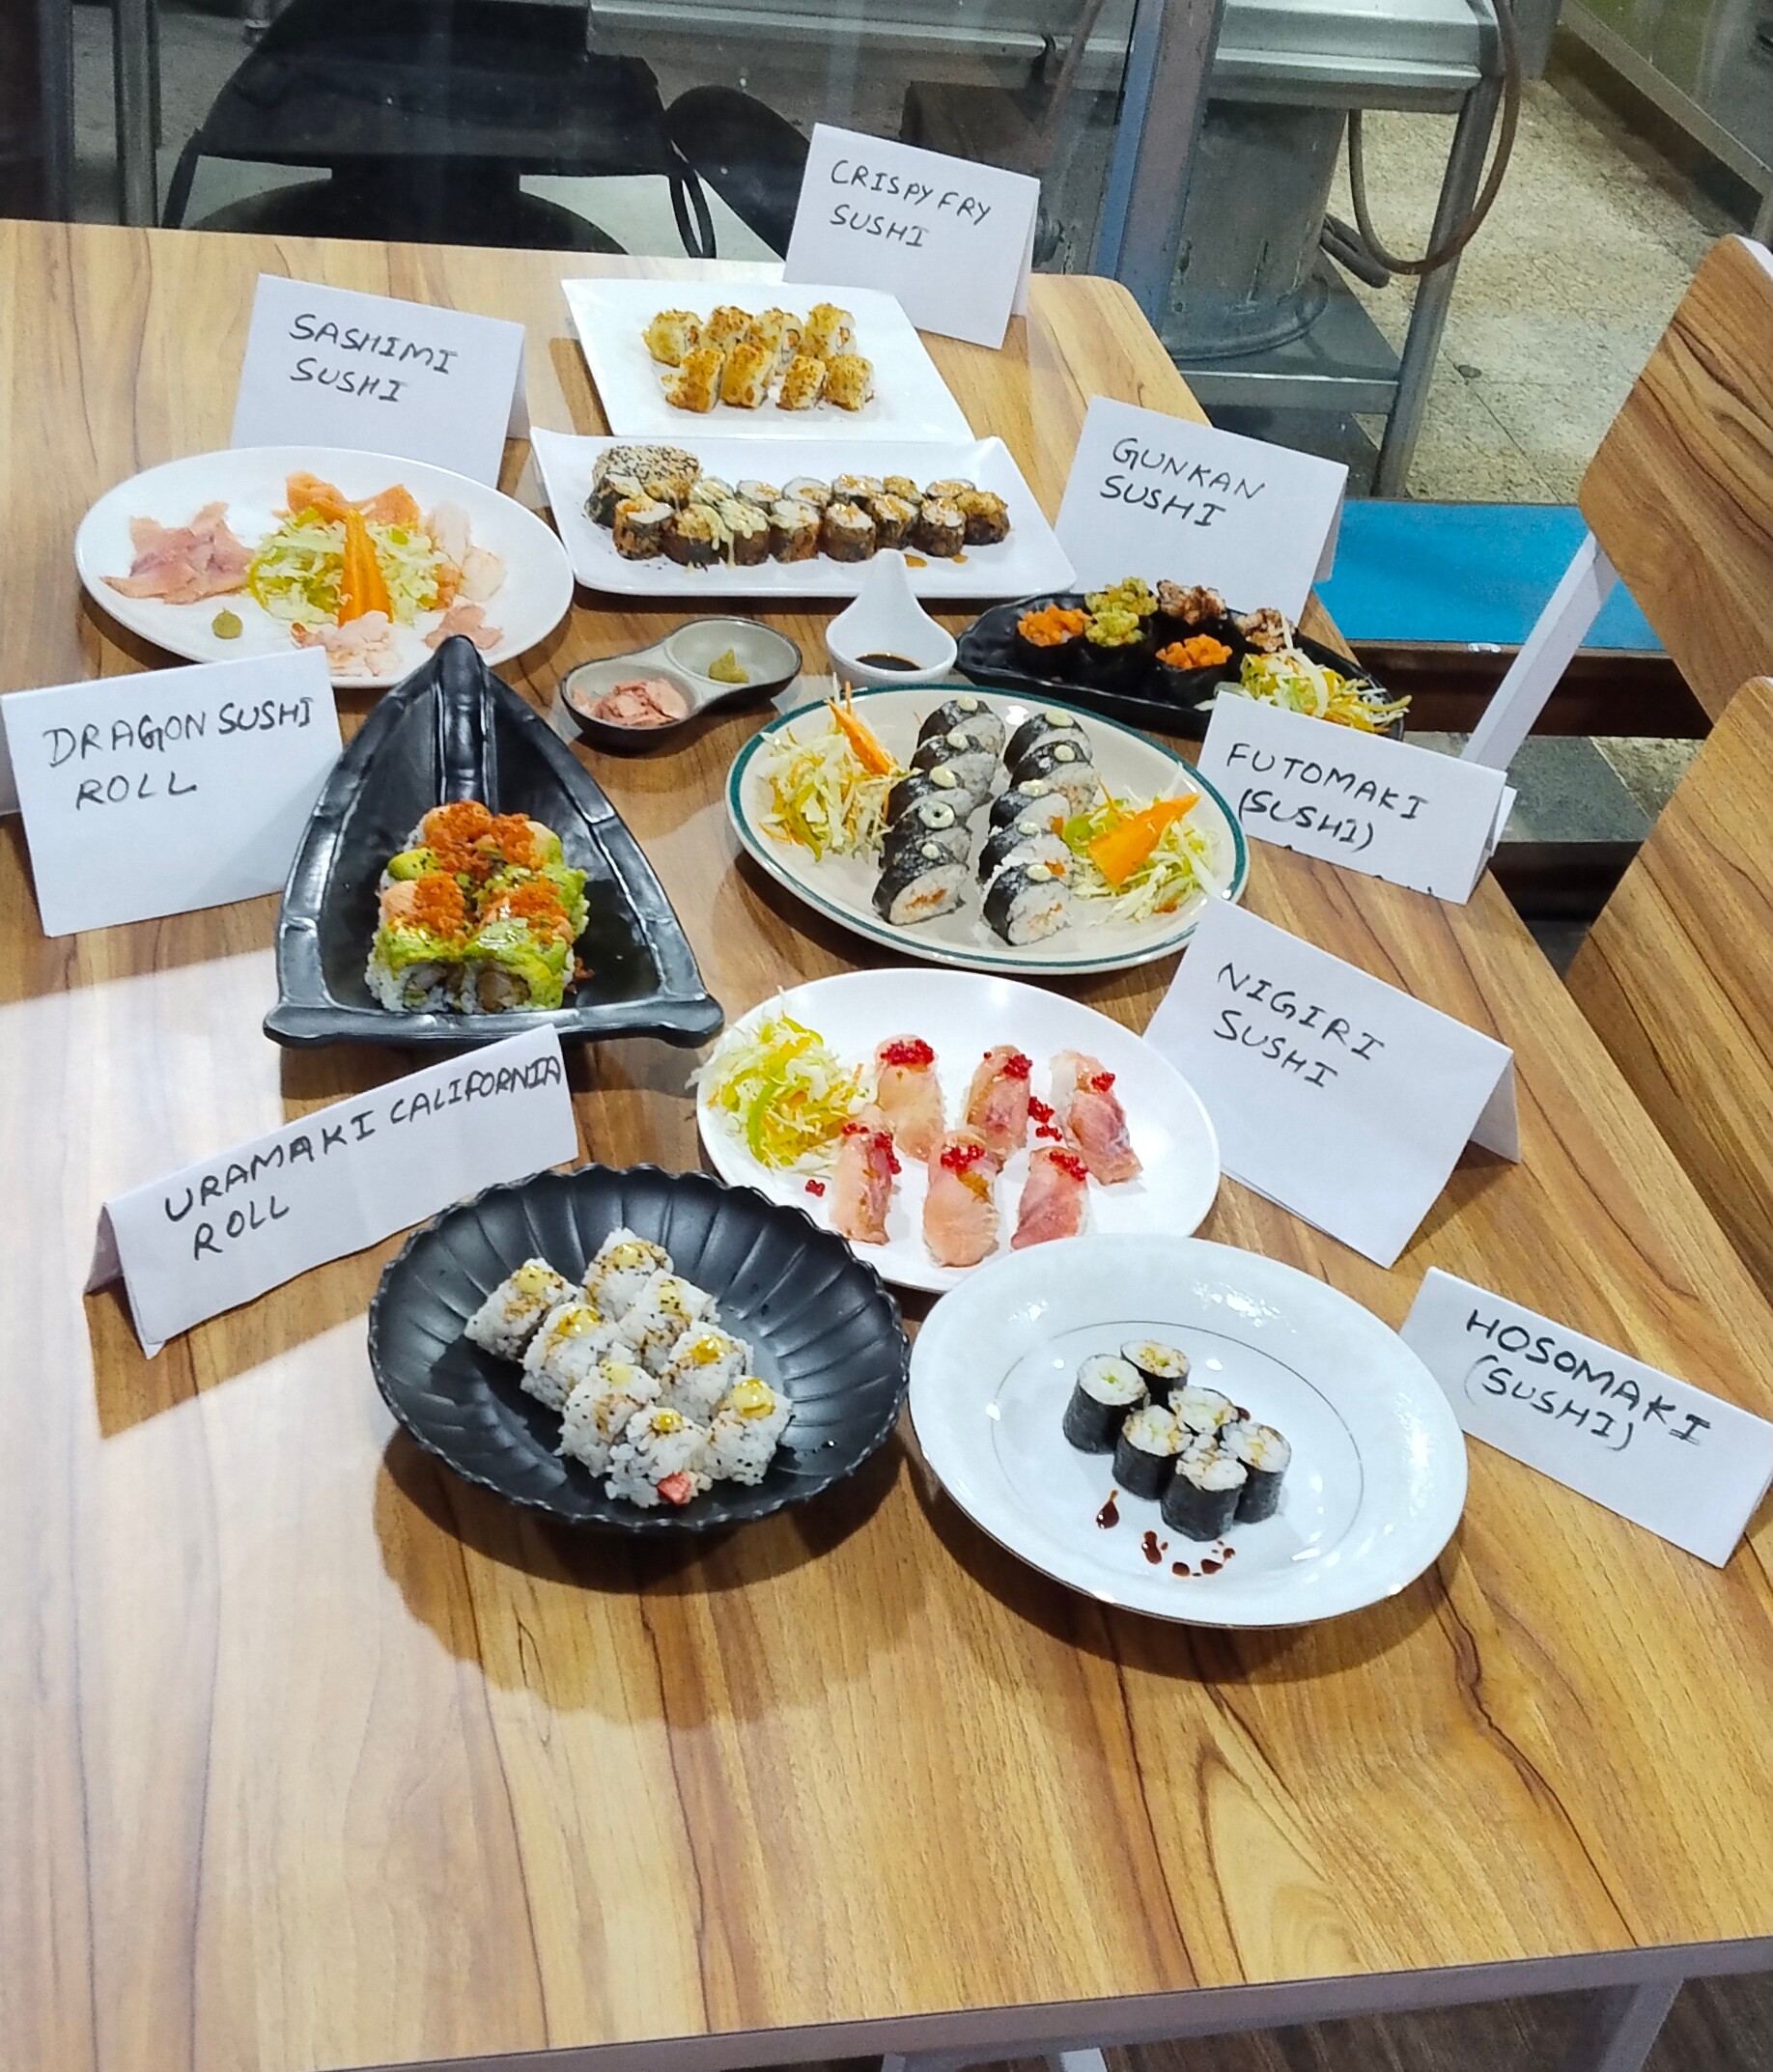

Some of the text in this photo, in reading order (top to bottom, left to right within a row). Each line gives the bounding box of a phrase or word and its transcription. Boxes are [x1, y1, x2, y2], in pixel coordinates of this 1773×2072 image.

[829, 203, 930, 248] SUSHI
[830, 159, 992, 226] CRISPY FRY
[289, 314, 458, 375] SASHIMI
[290, 357, 408, 403] SUSHI
[1099, 475, 1226, 526] SUSHI
[1112, 437, 1265, 499] GUNKAN
[42, 696, 314, 768] DRAGON SUSHI
[75, 770, 197, 810] ROLL
[1226, 742, 1429, 821] FUTOMAKI
[1238, 788, 1375, 853] (SUSHI)
[1217, 962, 1386, 1061] NIGIRI
[1213, 1009, 1338, 1088] SUSHI
[164, 1054, 562, 1222] URAMAKI CALIFORNIA
[193, 1194, 290, 1261] ROLL
[1463, 1354, 1634, 1451] (SUSHI)
[1465, 1308, 1711, 1446] HOSOMAKI
